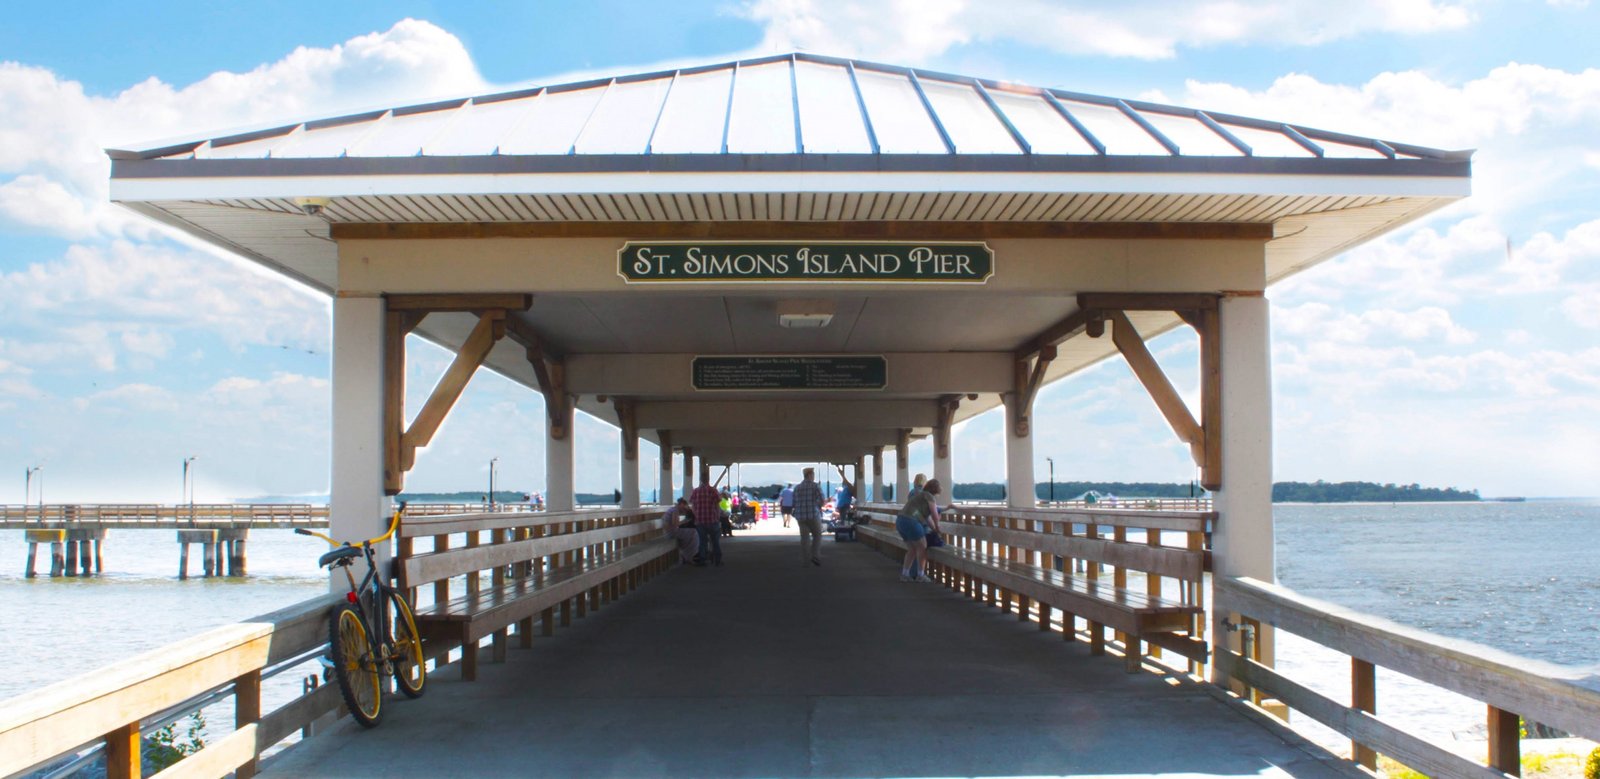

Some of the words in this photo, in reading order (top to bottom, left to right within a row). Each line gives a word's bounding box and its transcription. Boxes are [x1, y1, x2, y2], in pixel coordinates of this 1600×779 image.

[634, 247, 675, 274] ST.
[684, 247, 788, 274] SIMONS
[796, 247, 900, 274] ISLAND
[909, 246, 974, 274] PIER
